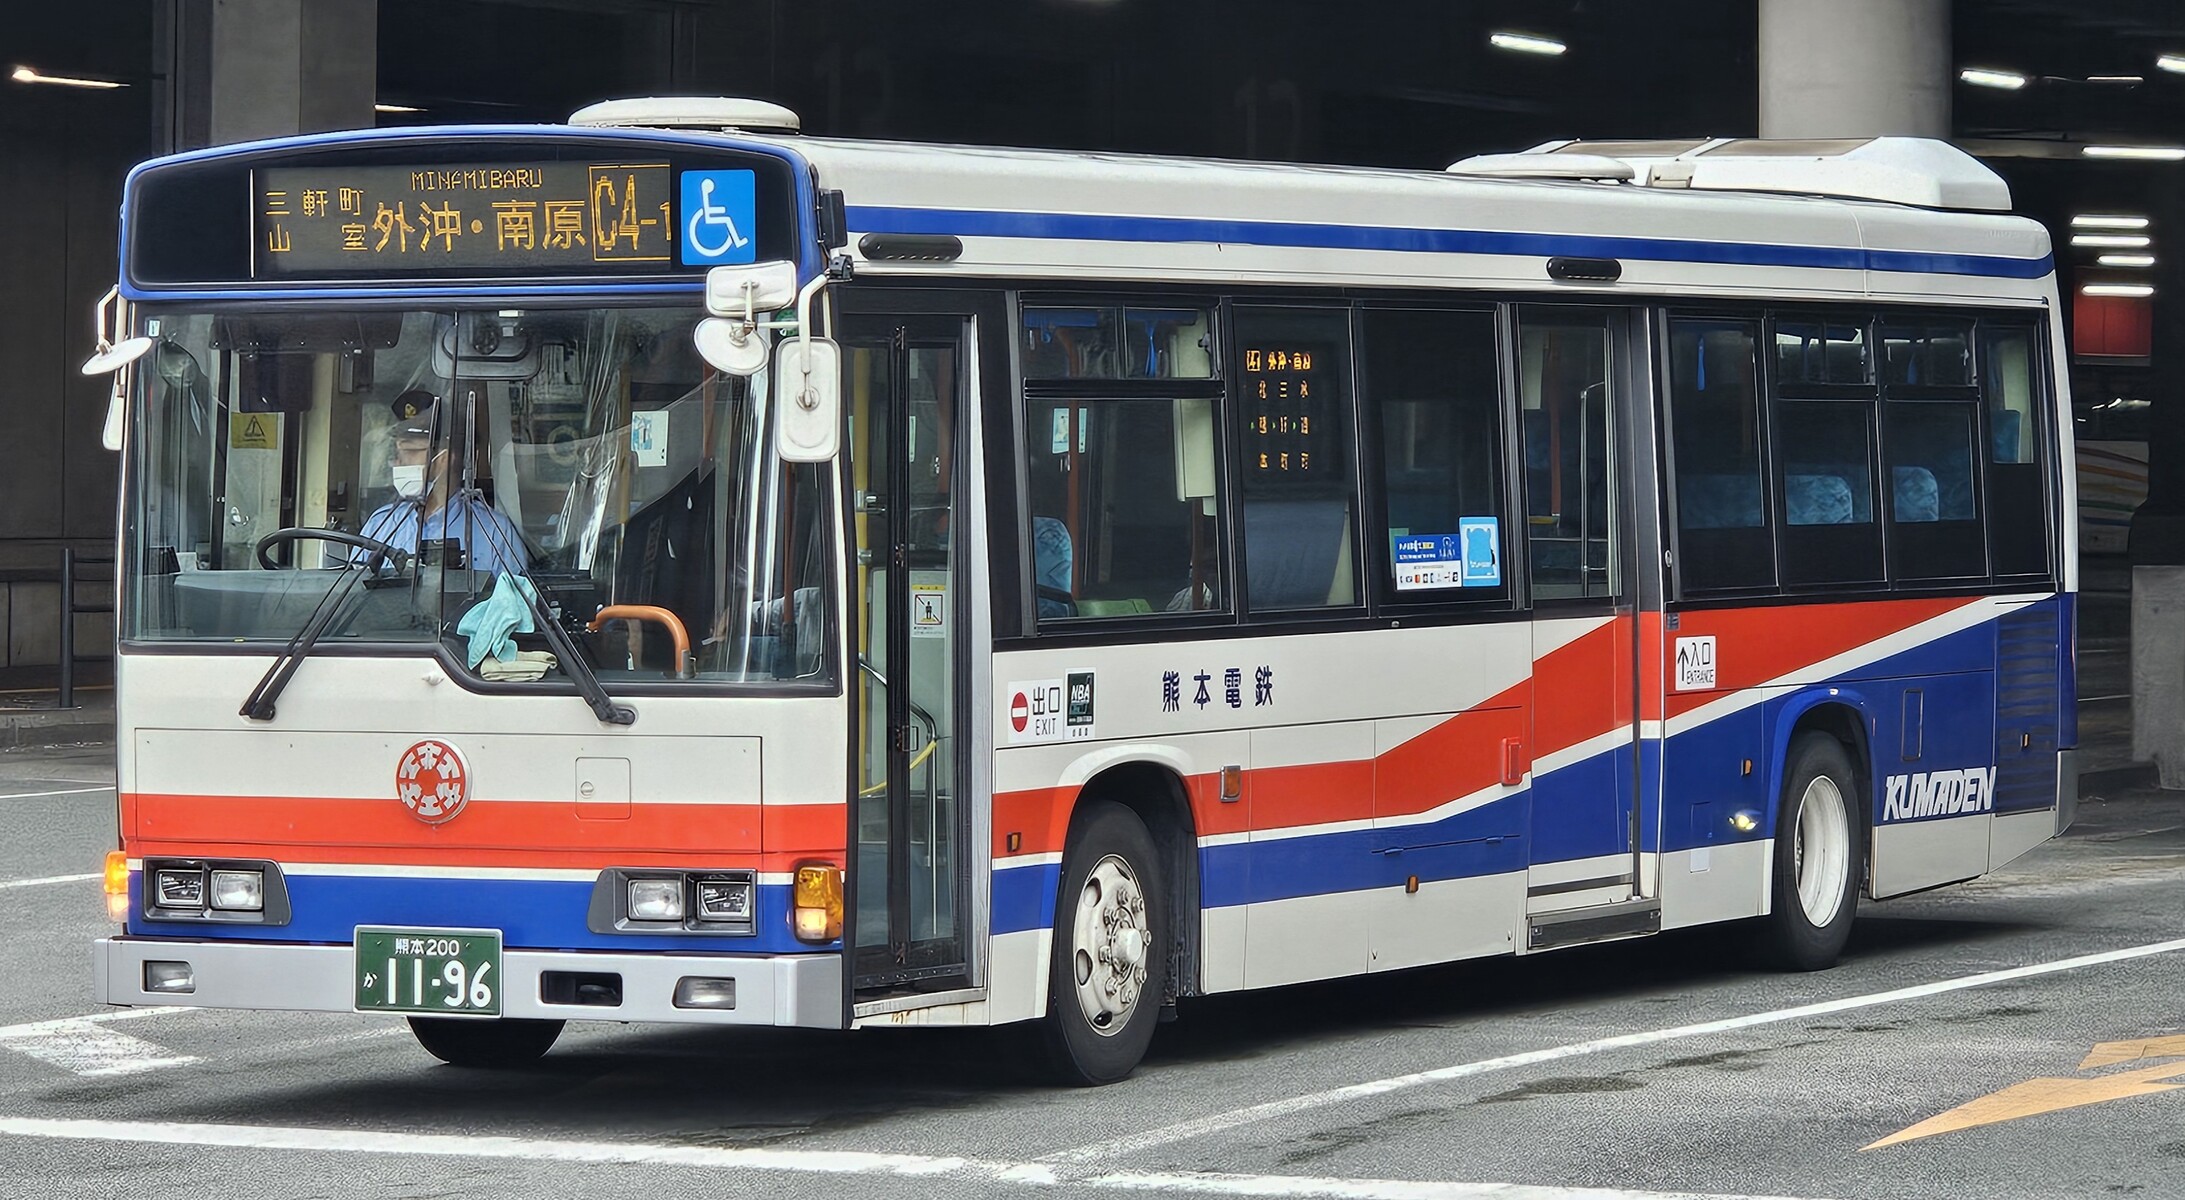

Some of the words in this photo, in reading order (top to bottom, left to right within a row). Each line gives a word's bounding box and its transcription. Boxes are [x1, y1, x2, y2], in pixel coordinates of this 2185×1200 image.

[266, 187, 364, 217] 三軒町
[1690, 642, 1711, 667] 入口
[1033, 686, 1060, 716] 出口
[1162, 664, 1273, 713] 熊本電鉄
[1035, 718, 1056, 736] EXIT
[1883, 766, 1997, 821] KUMADEN
[363, 972, 378, 988] か
[387, 957, 492, 1008] 11-96
